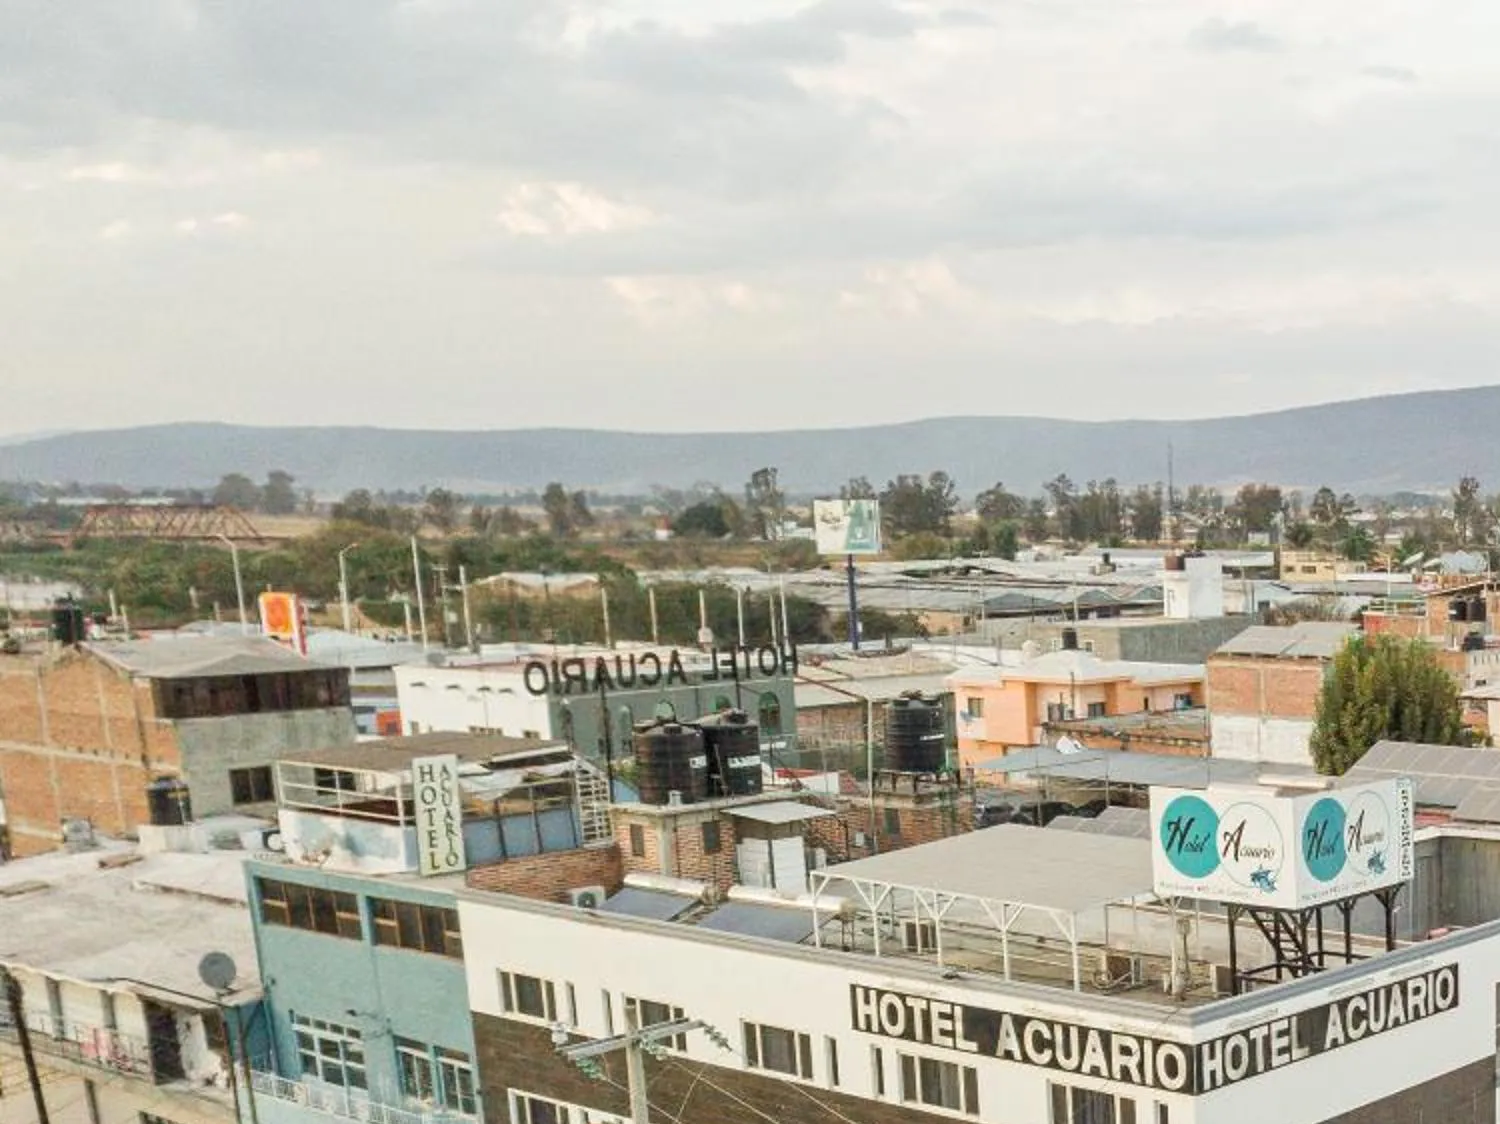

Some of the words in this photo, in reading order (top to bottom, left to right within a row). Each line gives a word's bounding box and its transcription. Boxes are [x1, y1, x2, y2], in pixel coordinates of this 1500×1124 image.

[418, 764, 440, 870] HOTEL
[441, 763, 459, 867] ACUARIO
[1223, 819, 1275, 863] Acuario
[855, 986, 978, 1053] HOTEL
[996, 1012, 1187, 1091] ACUARIO
[1202, 1015, 1309, 1091] HOTEL
[1322, 968, 1456, 1050] ACUARIO
